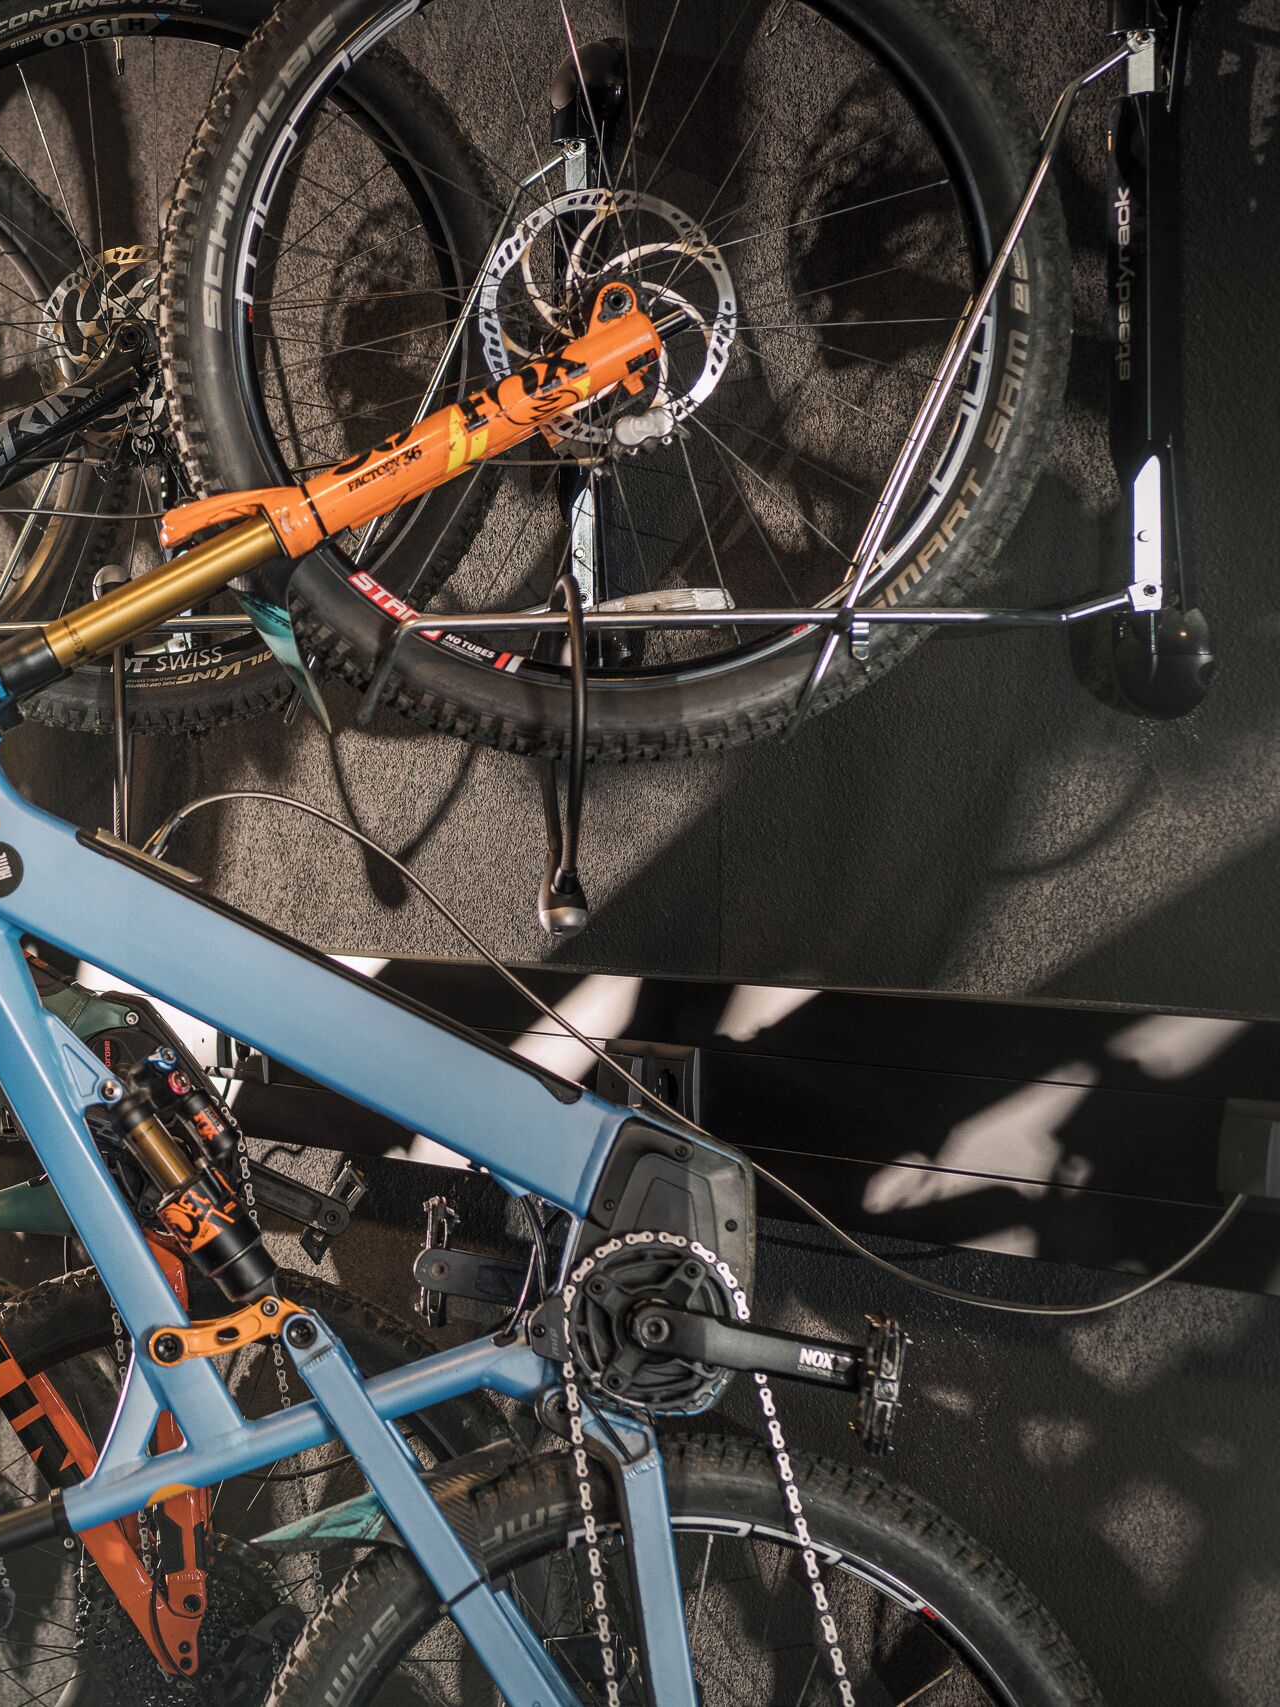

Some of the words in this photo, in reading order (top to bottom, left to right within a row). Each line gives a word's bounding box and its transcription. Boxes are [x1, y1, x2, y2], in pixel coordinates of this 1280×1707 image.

[203, 14, 338, 331] SCHWALBE
[1113, 186, 1136, 382] steadyrack
[983, 329, 1030, 454] SAM
[155, 646, 223, 673] SWISS
[444, 634, 463, 647] NO
[461, 640, 496, 660] TUBES
[799, 1347, 835, 1371] NOX
